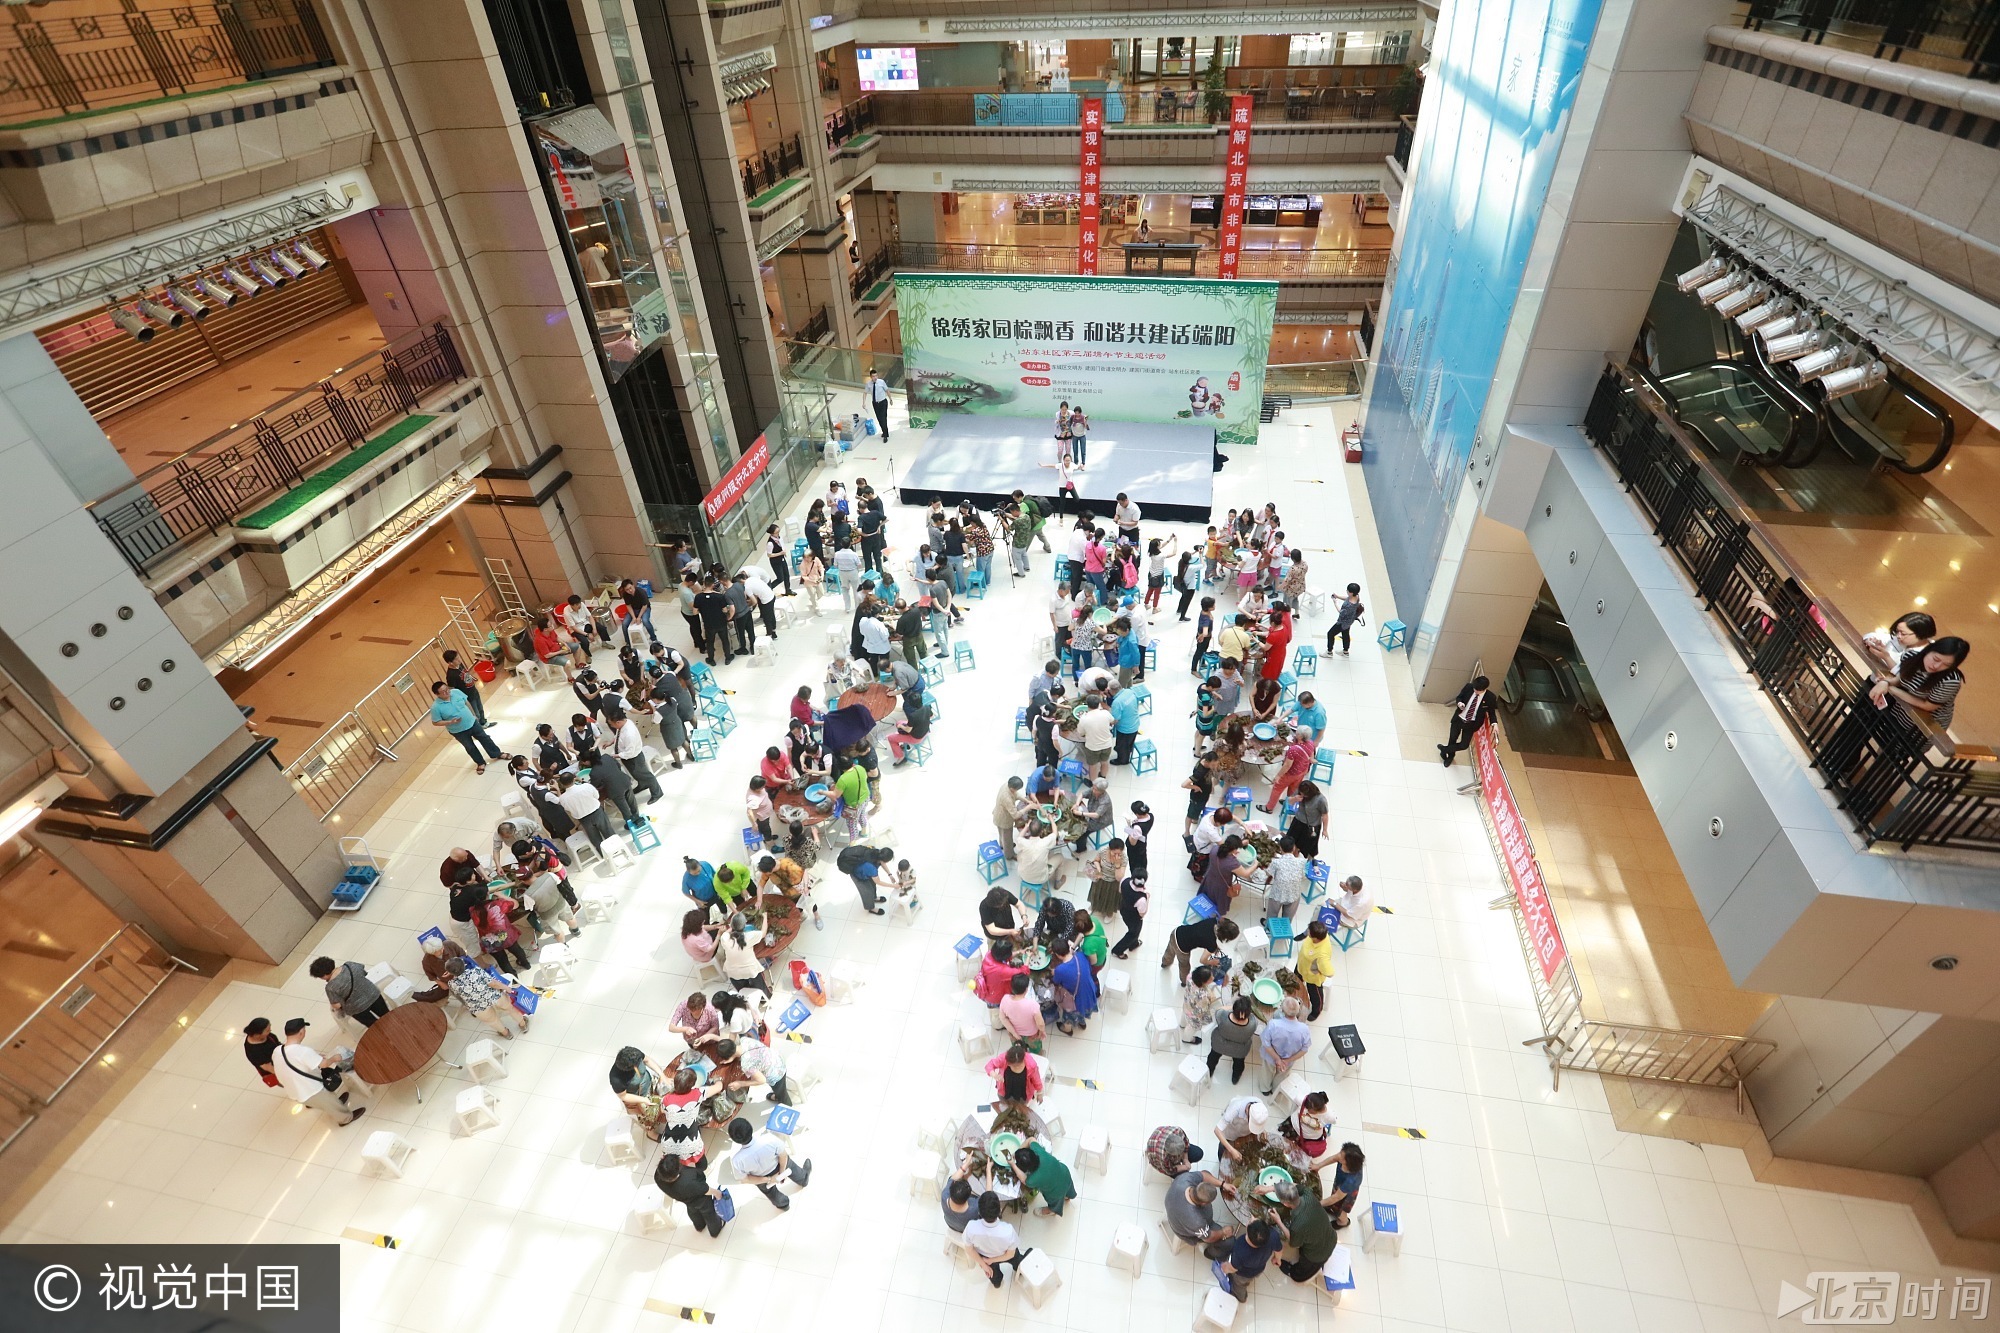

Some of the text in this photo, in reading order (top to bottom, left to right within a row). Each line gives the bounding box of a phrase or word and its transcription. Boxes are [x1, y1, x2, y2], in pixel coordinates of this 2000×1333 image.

[1020, 348, 1167, 361] 站东社区第三届端午节主题活动
[1083, 321, 1236, 346] 和谐共建话端阳
[713, 444, 767, 511] 锦州银行北京分行
[1492, 786, 1557, 965] 免费赠送健康服务大礼包
